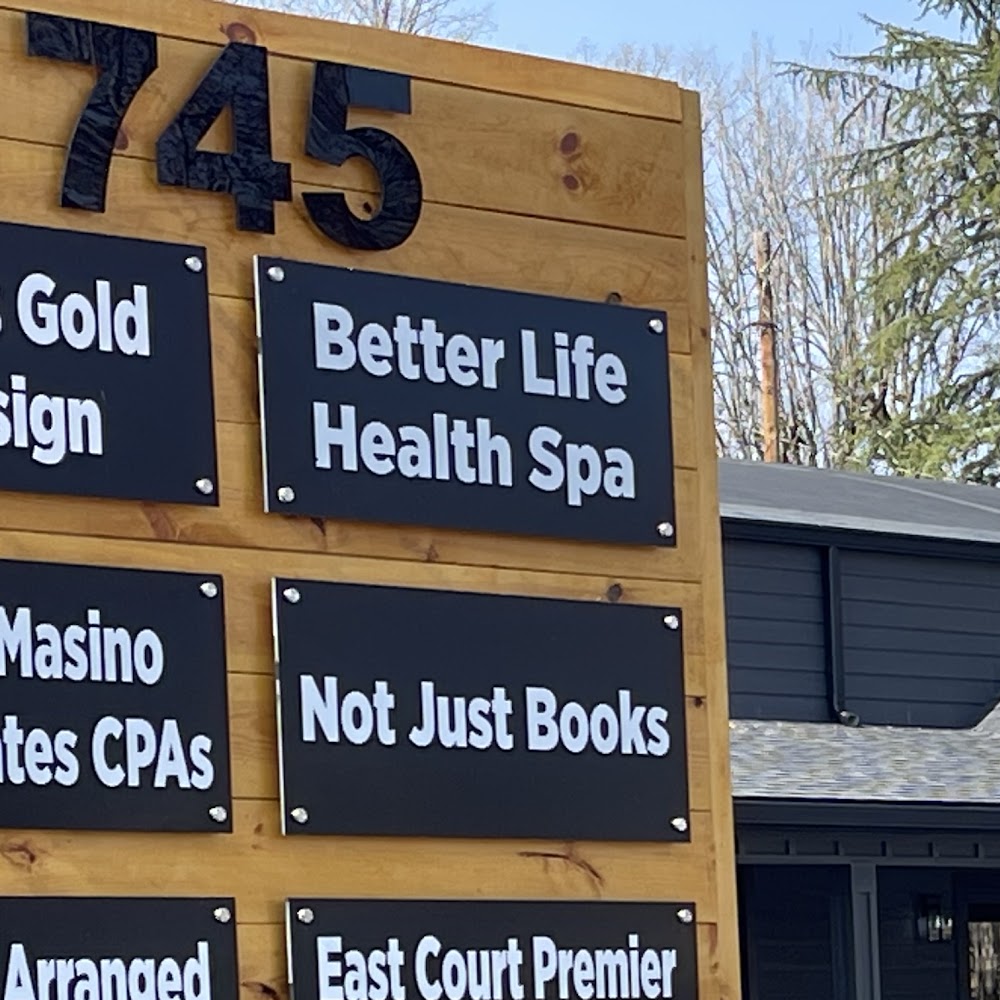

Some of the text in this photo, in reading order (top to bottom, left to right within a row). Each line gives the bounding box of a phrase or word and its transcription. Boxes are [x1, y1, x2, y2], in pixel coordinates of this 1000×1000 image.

[26, 12, 423, 251] 745
[18, 273, 150, 356] Gold
[313, 302, 627, 403] Better Life
[314, 402, 635, 506] Health Spa
[0, 606, 163, 684] Masino
[0, 716, 213, 789] tes CPAs
[301, 675, 669, 756] Not Just Books
[533, 934, 676, 1000] Premier
